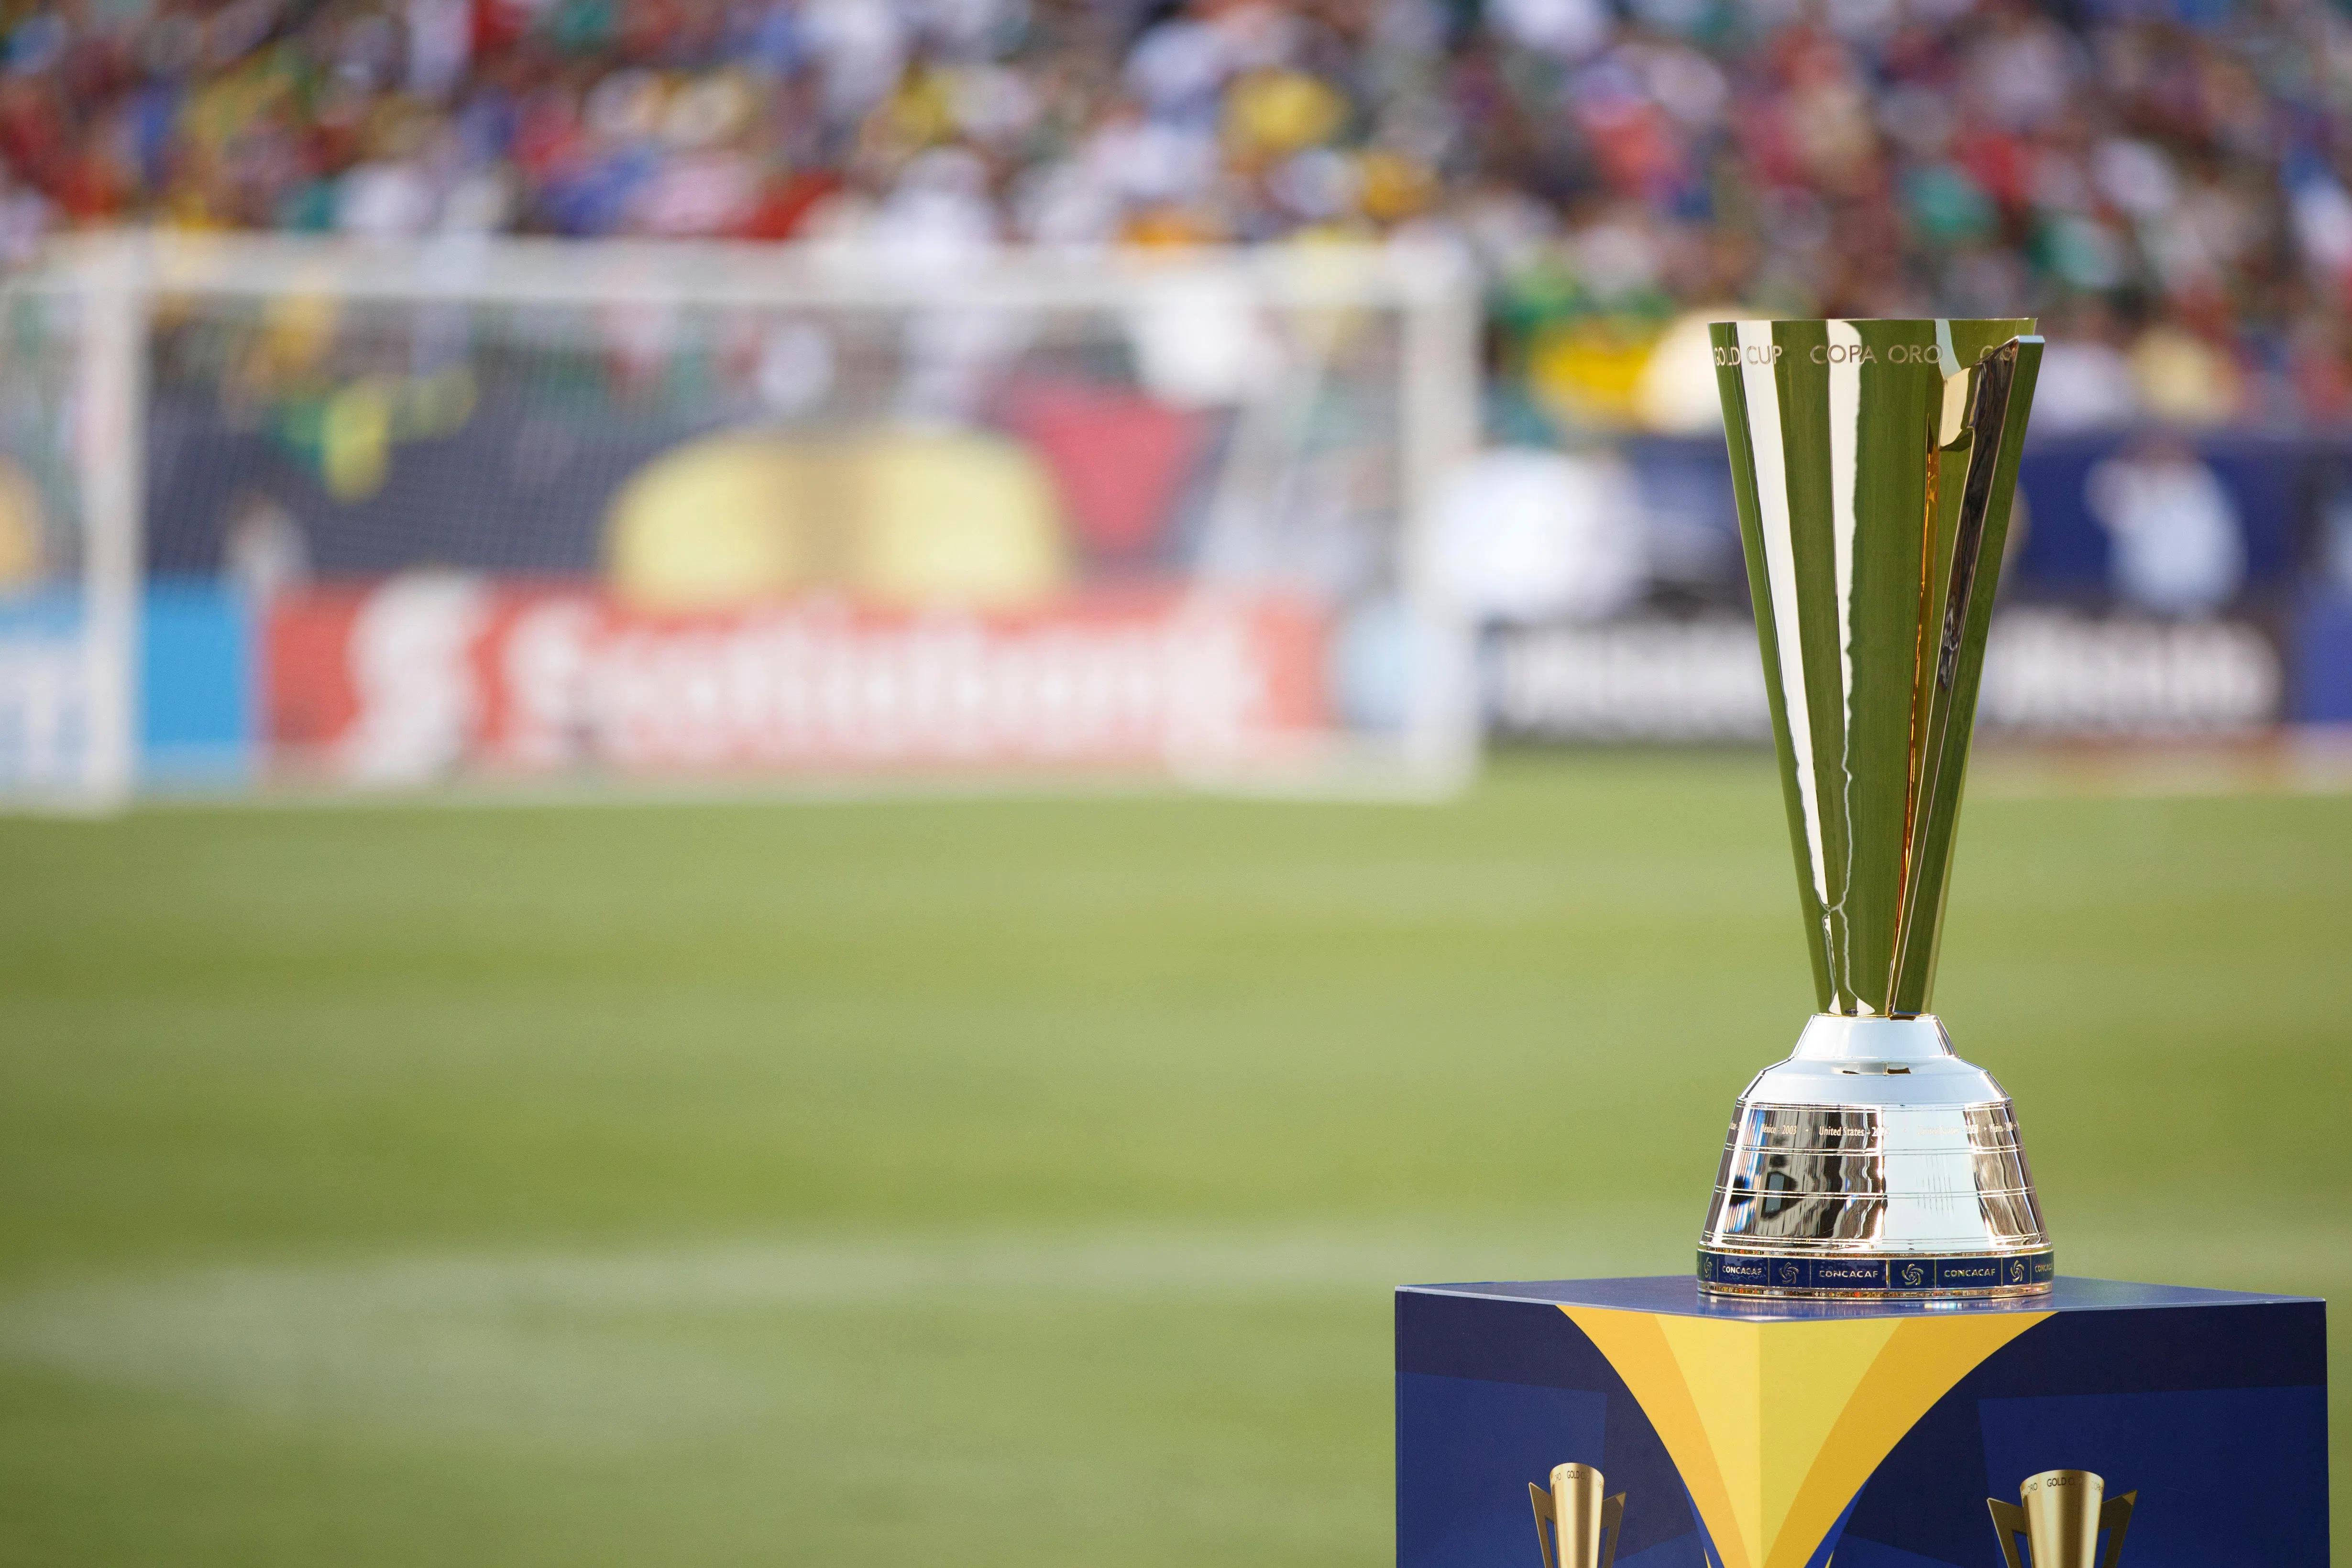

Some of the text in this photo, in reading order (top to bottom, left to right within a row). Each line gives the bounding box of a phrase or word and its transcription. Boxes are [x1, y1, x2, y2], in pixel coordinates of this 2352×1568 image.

[1715, 345, 1782, 366] GOLD CUP
[1810, 344, 1943, 364] COPA ORO
[1782, 1125, 1797, 1135] 2003
[1819, 1126, 1841, 1136] United
[1843, 1126, 1864, 1137] States
[1722, 1266, 1762, 1275] CONCACAF
[1944, 1269, 1996, 1277] CONCACAF
[1567, 1470, 1580, 1479] GOLD
[2047, 1477, 2066, 1487] GOLD
